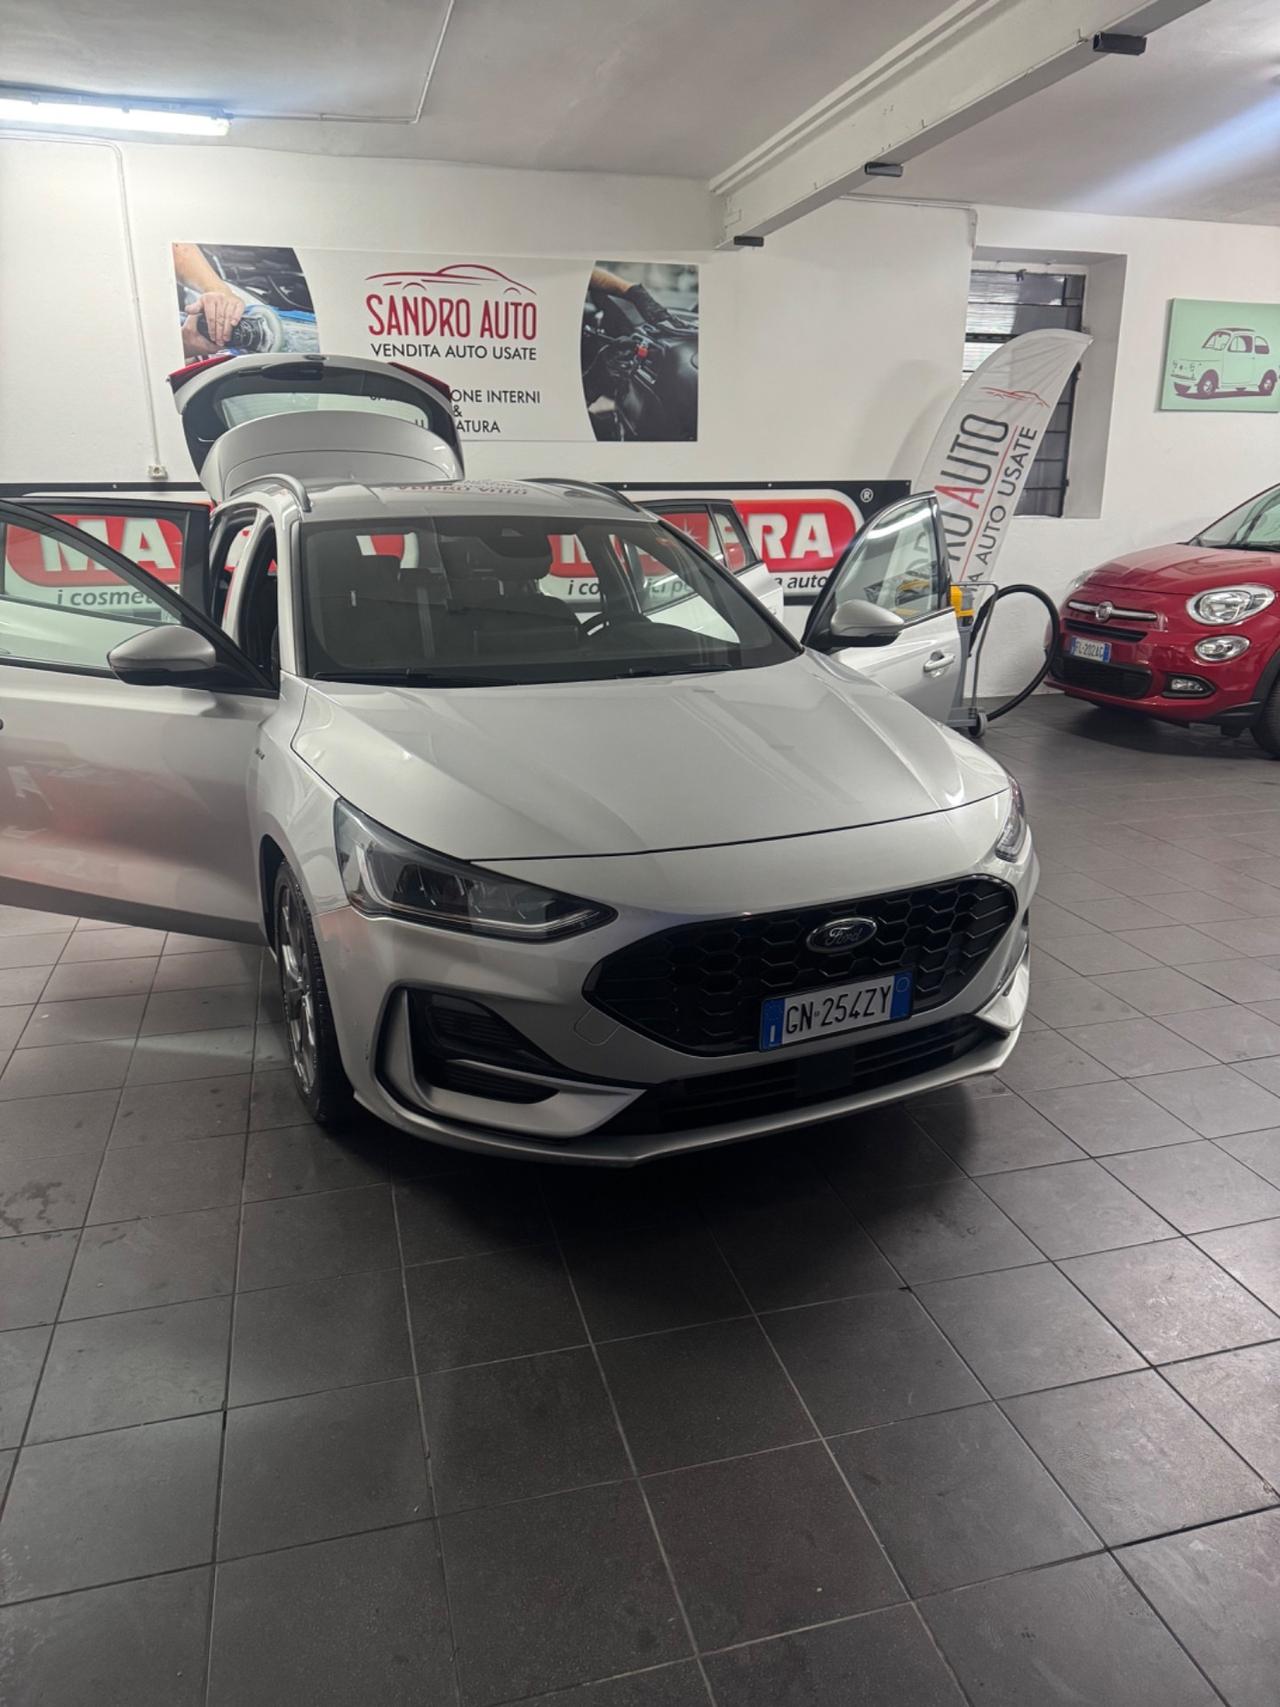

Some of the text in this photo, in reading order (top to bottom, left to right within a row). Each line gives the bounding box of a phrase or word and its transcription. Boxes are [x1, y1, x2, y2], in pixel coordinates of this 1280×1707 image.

[366, 293, 537, 341] SANDRO AUTO
[371, 343, 537, 361] VENDITA AUTO USATE
[487, 390, 541, 404] INTERNI
[453, 404, 463, 418] &
[934, 413, 1009, 510] AUTO
[975, 505, 1006, 566] AUTO
[997, 426, 1038, 498] USATE
[787, 575, 829, 589] auto
[825, 925, 864, 946] Ford
